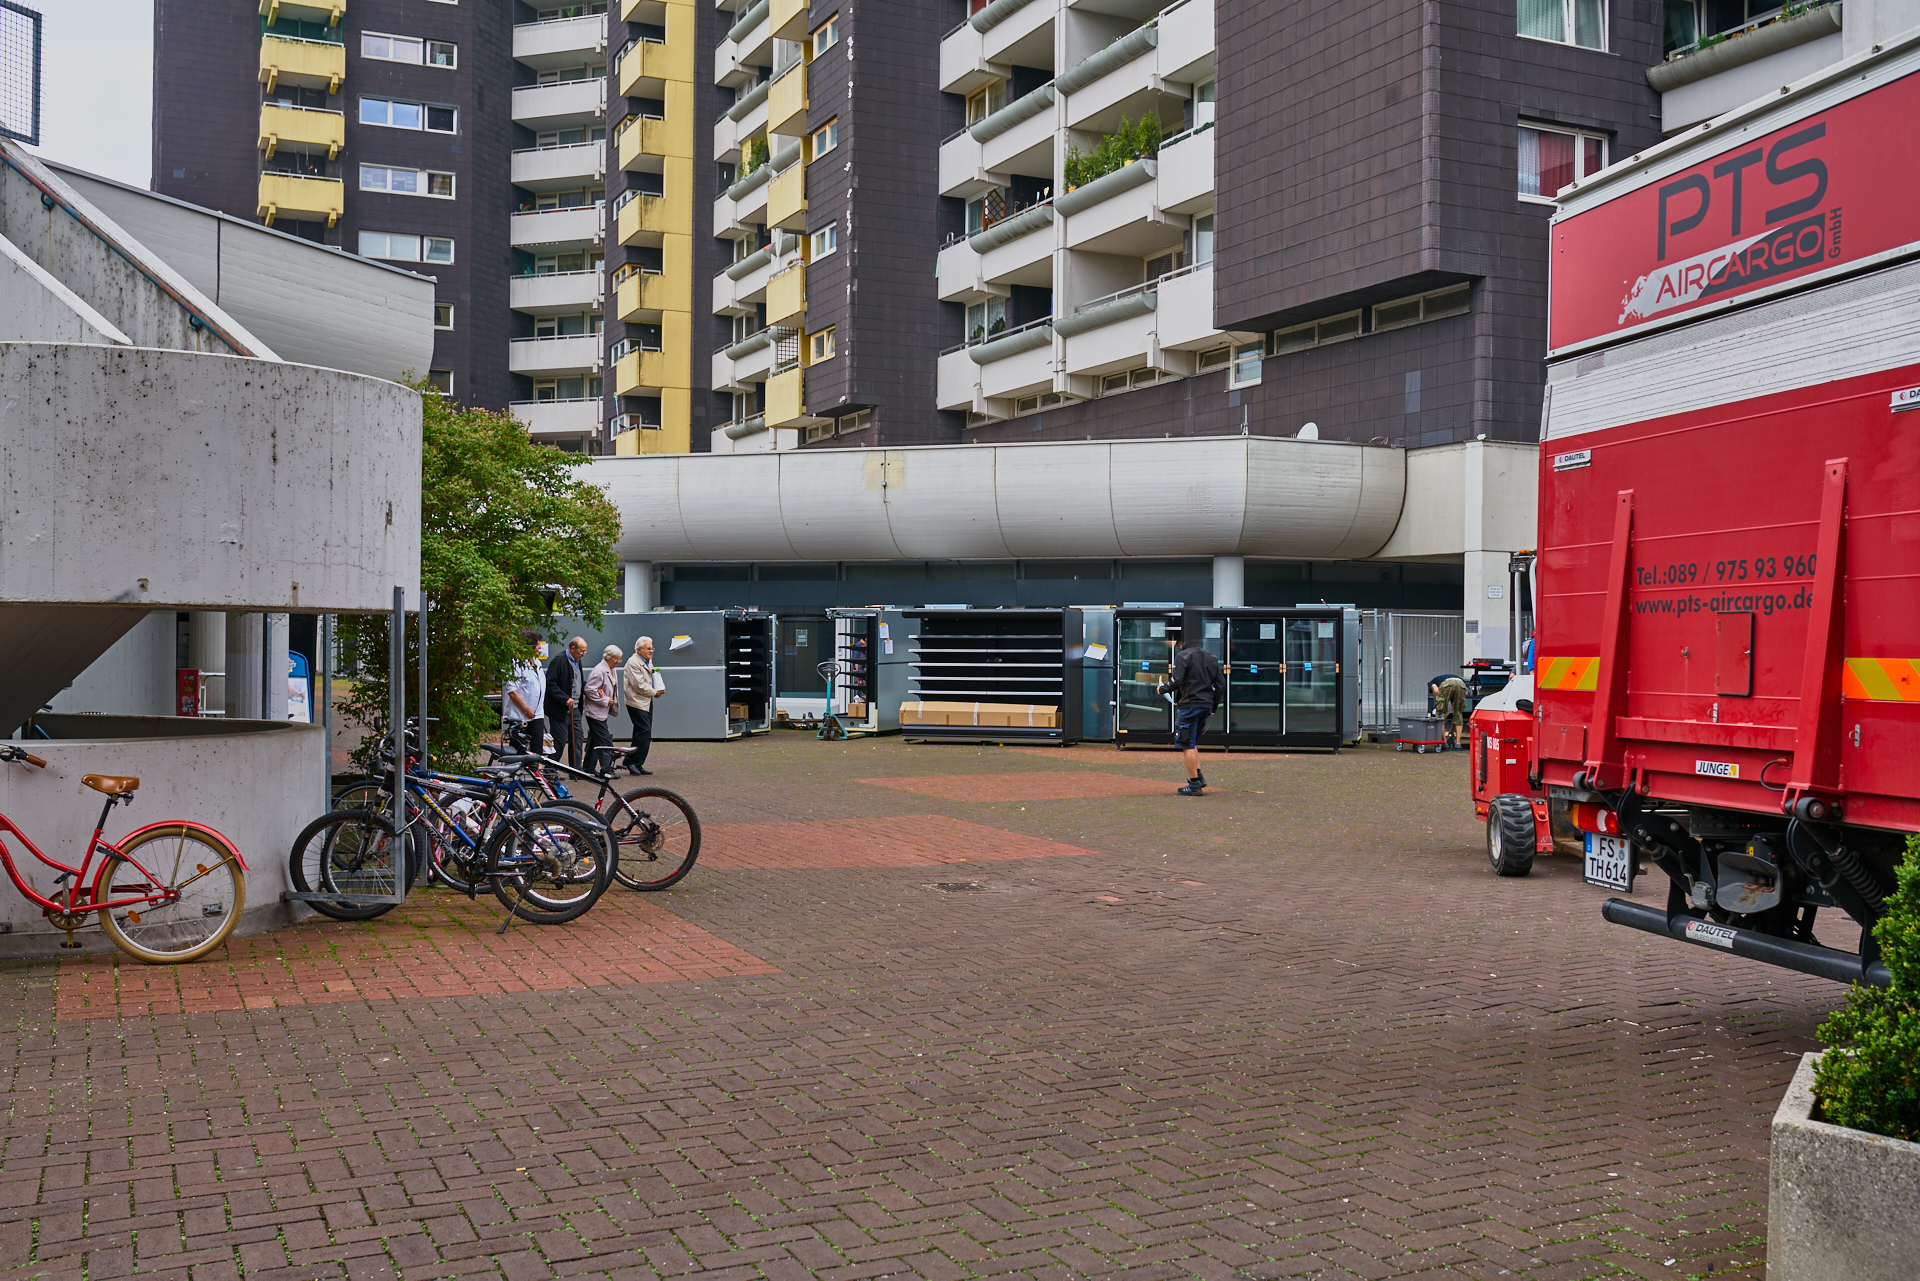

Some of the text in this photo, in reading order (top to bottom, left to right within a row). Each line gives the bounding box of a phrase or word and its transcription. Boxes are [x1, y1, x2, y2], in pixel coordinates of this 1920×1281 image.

[1657, 121, 1829, 262] PTS
[1828, 206, 1842, 259] GmbH
[1655, 224, 1823, 304] AIRCARGO
[1565, 453, 1585, 461] DAUTEL
[1716, 559, 1748, 581] 975
[1754, 557, 1776, 579] 93
[1783, 553, 1817, 577] 960
[1635, 585, 1813, 619] www.pts-aircargo.de
[1698, 761, 1730, 776] JUNGE
[421, 793, 455, 827] SHANNON
[1599, 837, 1615, 858] FS
[1589, 856, 1627, 884] TH614
[1695, 923, 1734, 940] DAUTEL
